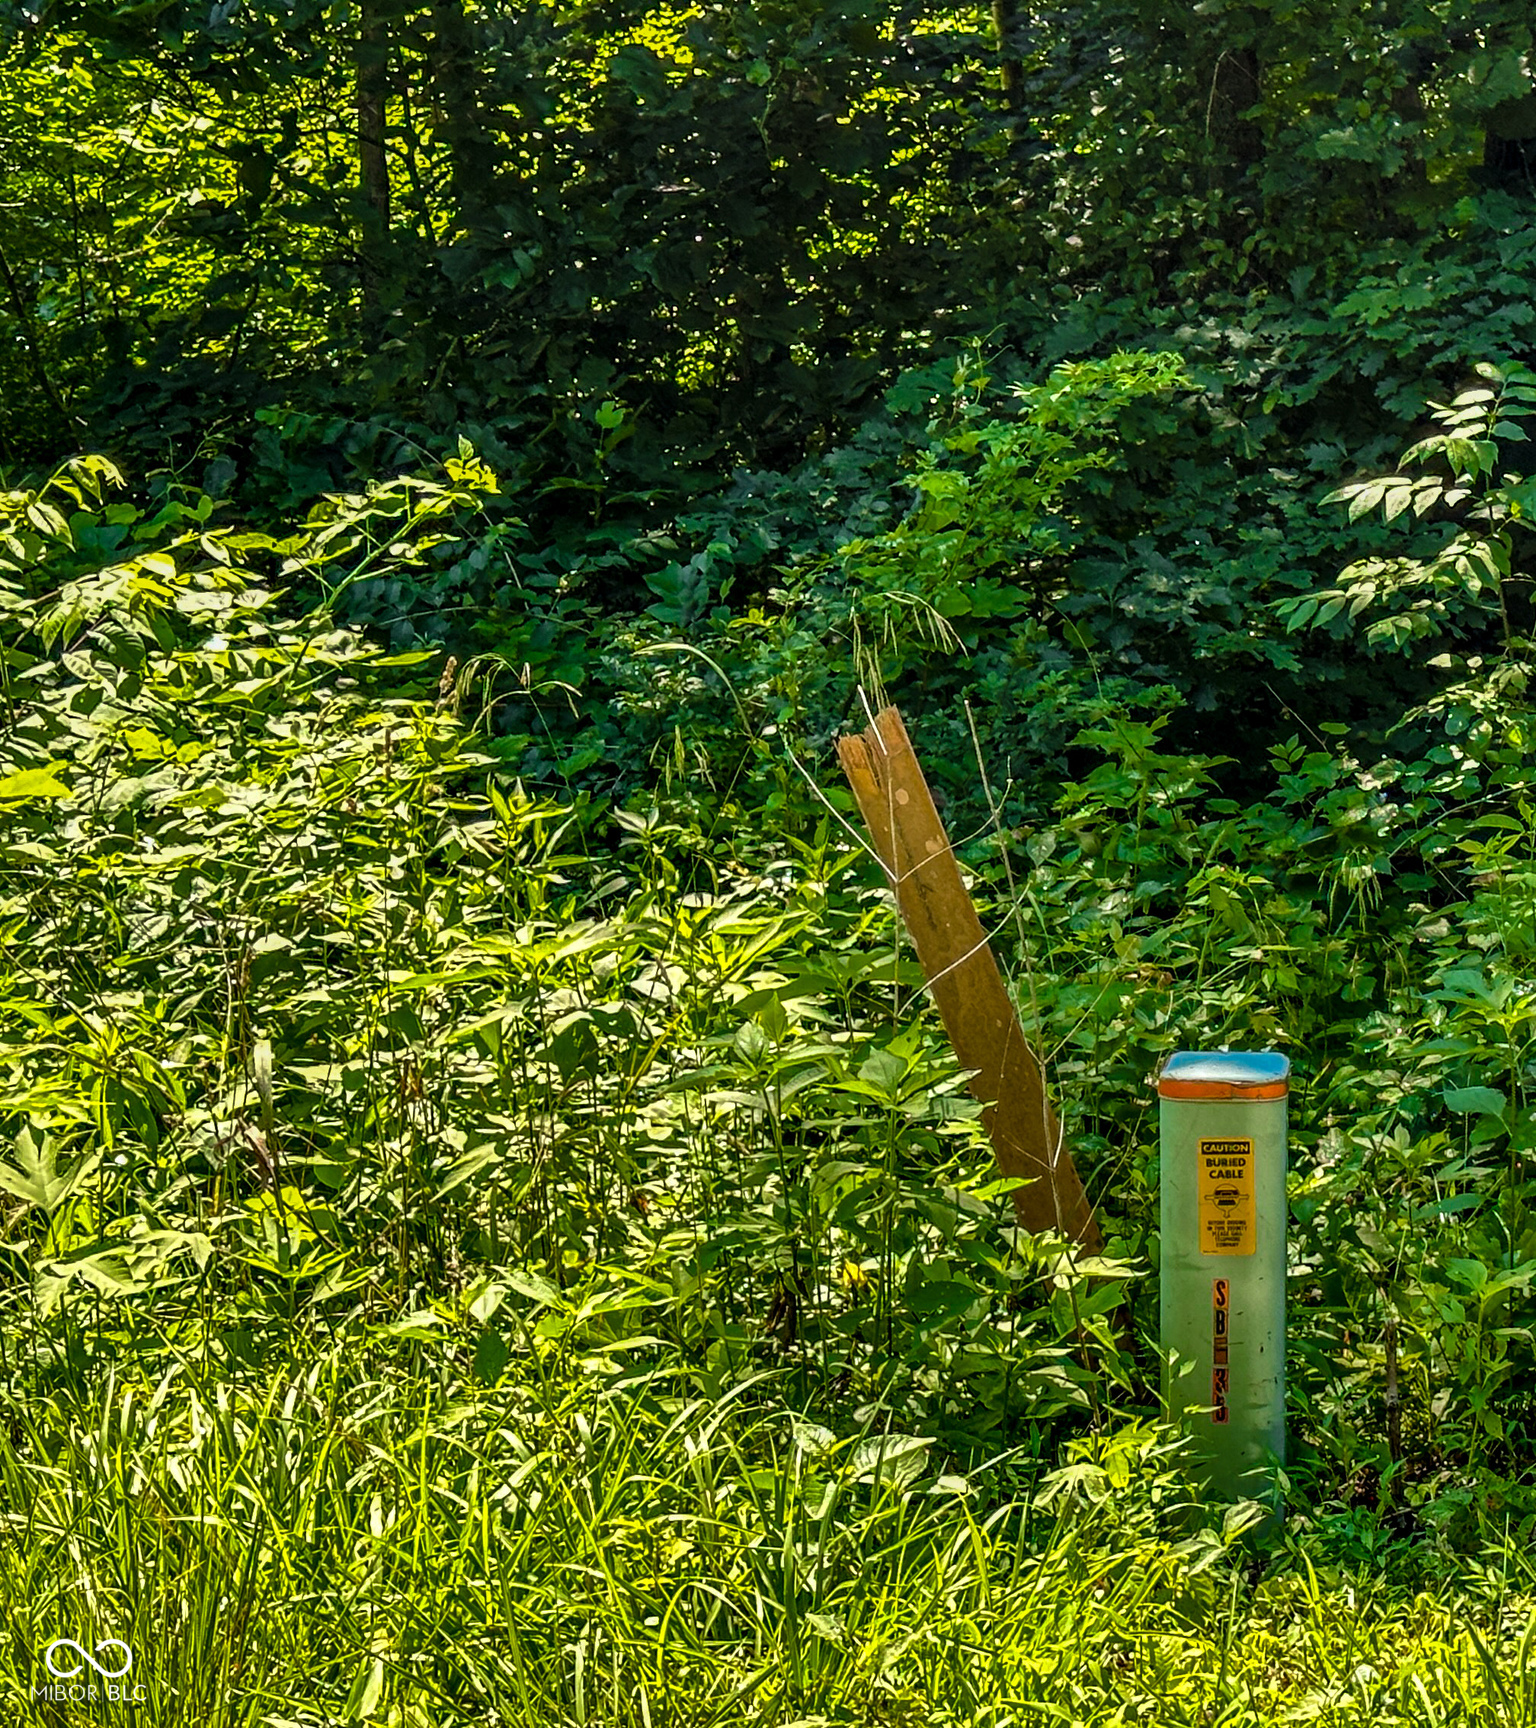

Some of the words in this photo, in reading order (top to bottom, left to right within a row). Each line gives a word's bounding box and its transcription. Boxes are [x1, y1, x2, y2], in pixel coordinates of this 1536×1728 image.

[1203, 1143, 1249, 1153] CAUTION
[1206, 1158, 1246, 1167] BURIED
[1209, 1170, 1244, 1179] CABLE
